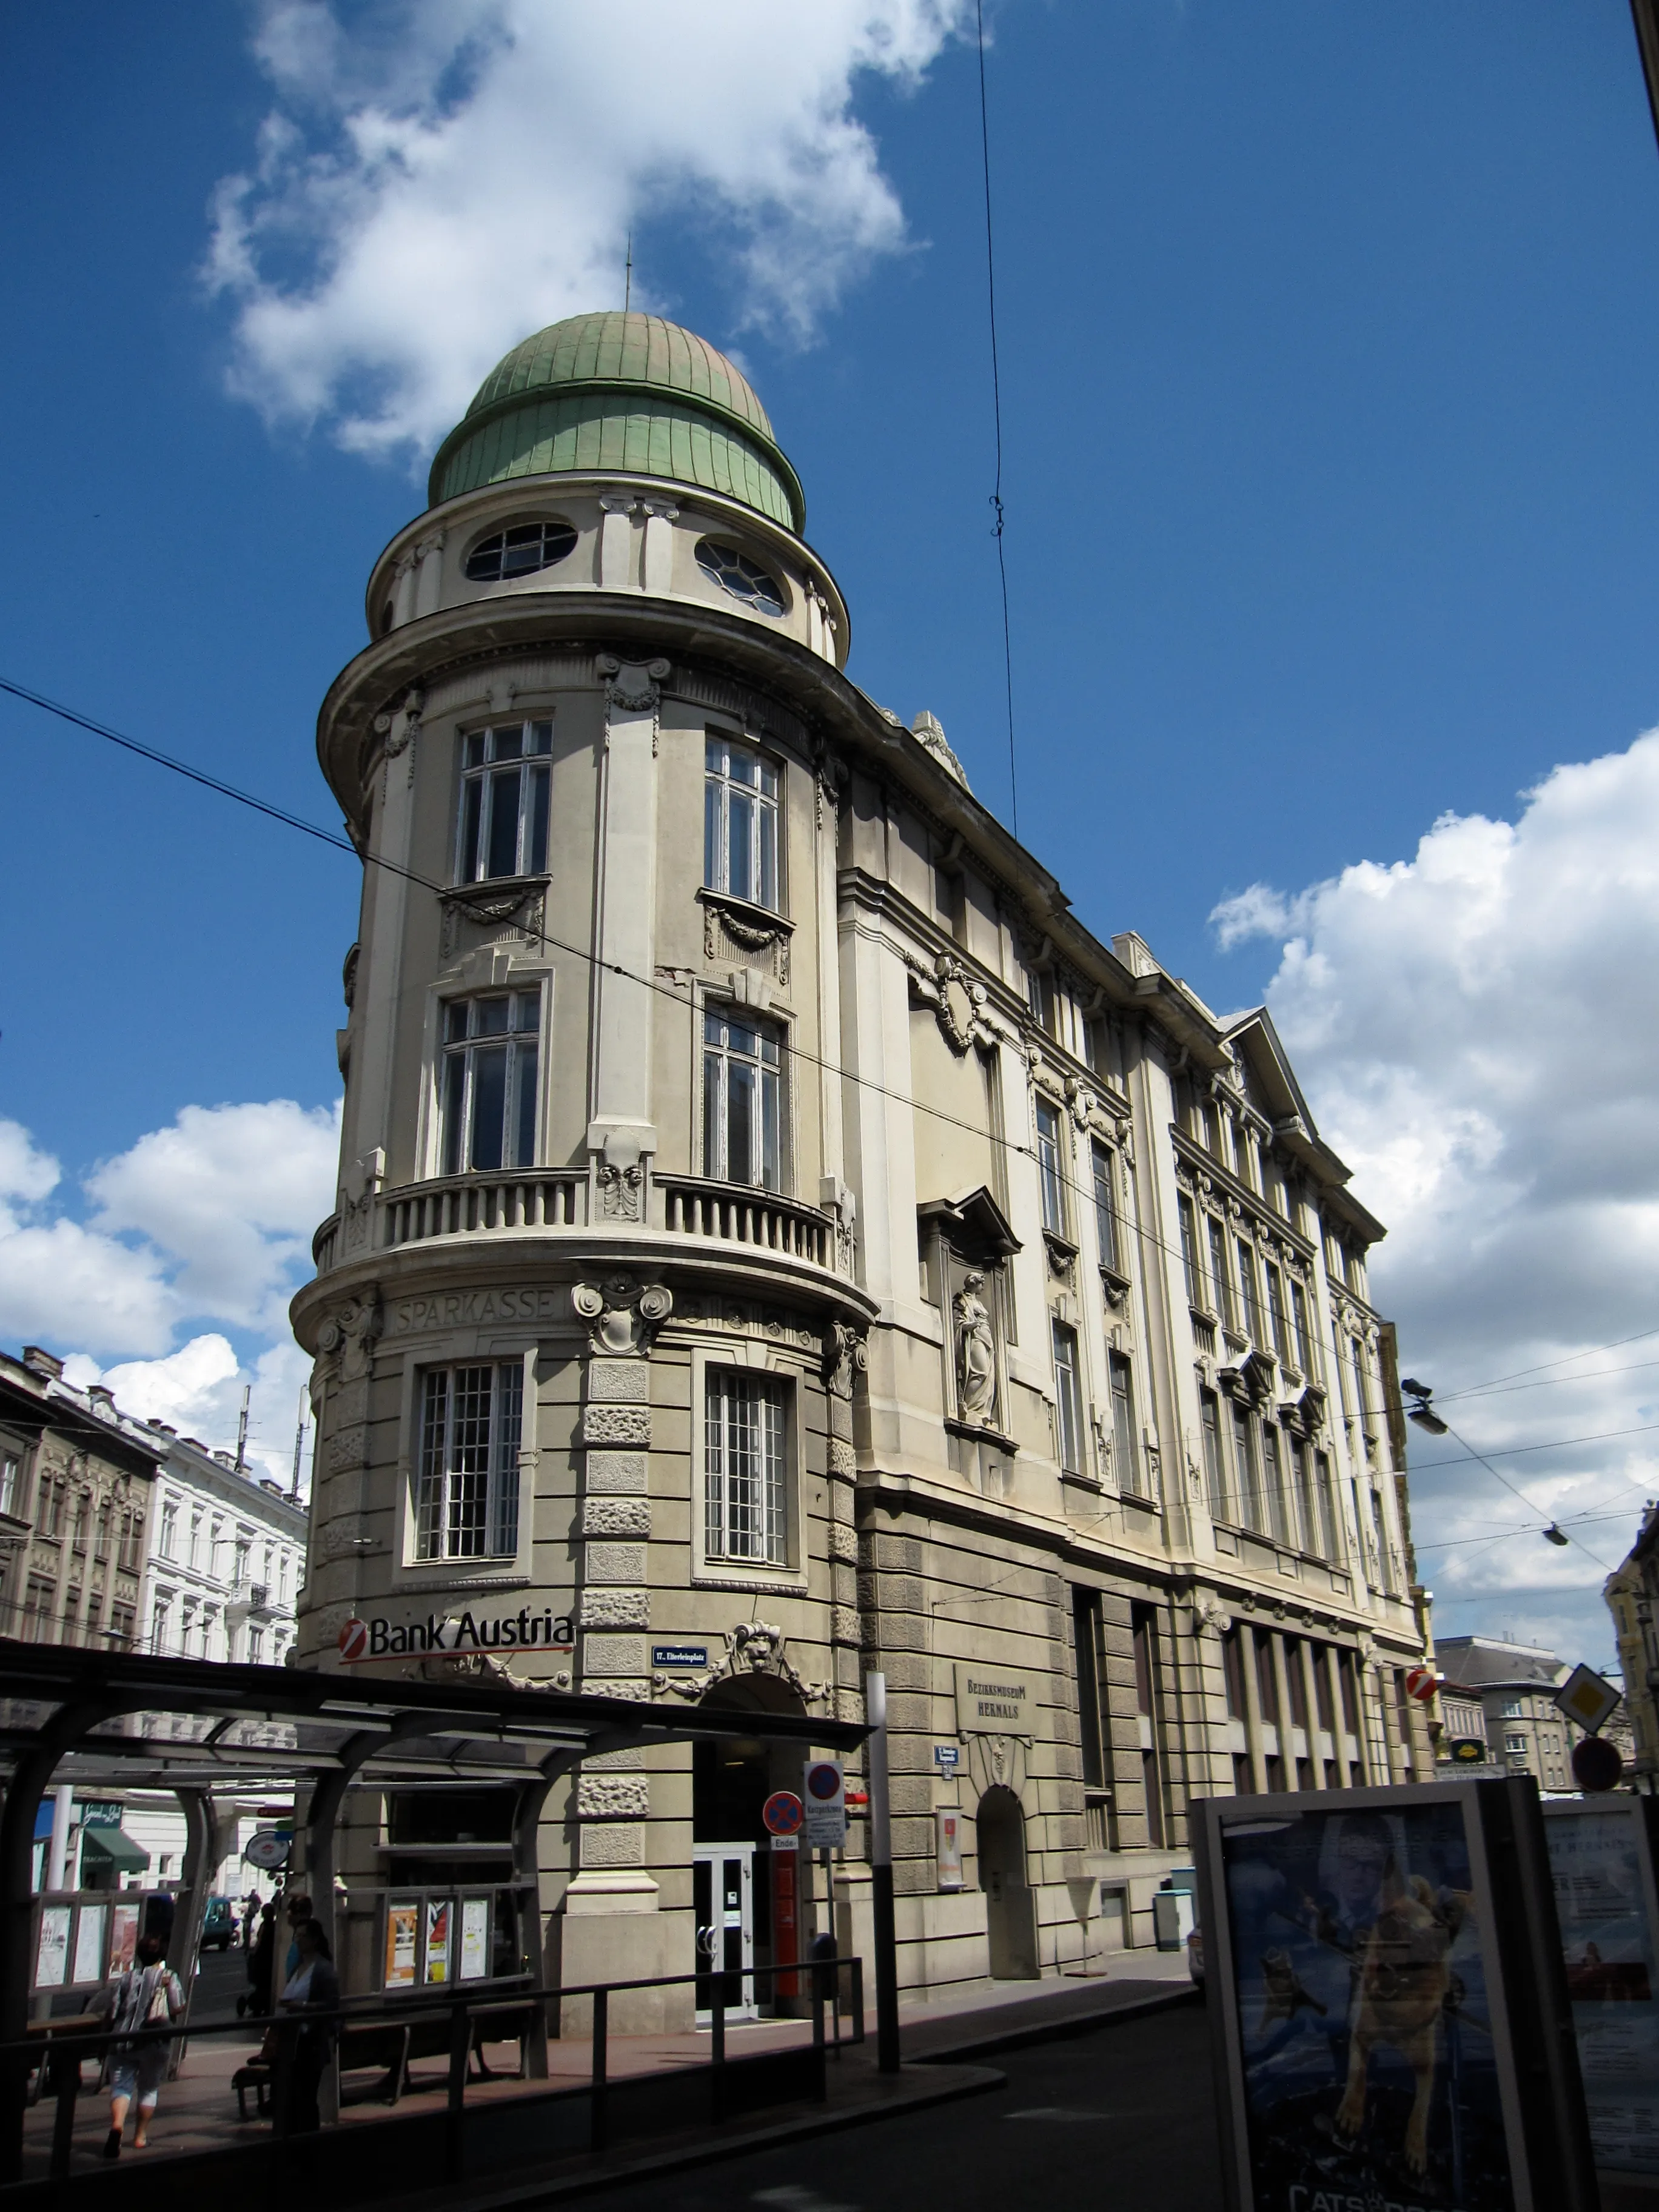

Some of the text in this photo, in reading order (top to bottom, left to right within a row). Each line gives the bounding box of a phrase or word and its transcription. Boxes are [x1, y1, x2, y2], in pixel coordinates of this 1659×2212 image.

[397, 1289, 555, 1332] SPARKASSE
[370, 1607, 574, 1655] Bank Austria
[666, 1652, 705, 1663] Elterleinplatz
[978, 1701, 1019, 1720] HERNALS
[776, 1838, 794, 1848] Ende
[1289, 2184, 1366, 2212] CATS
